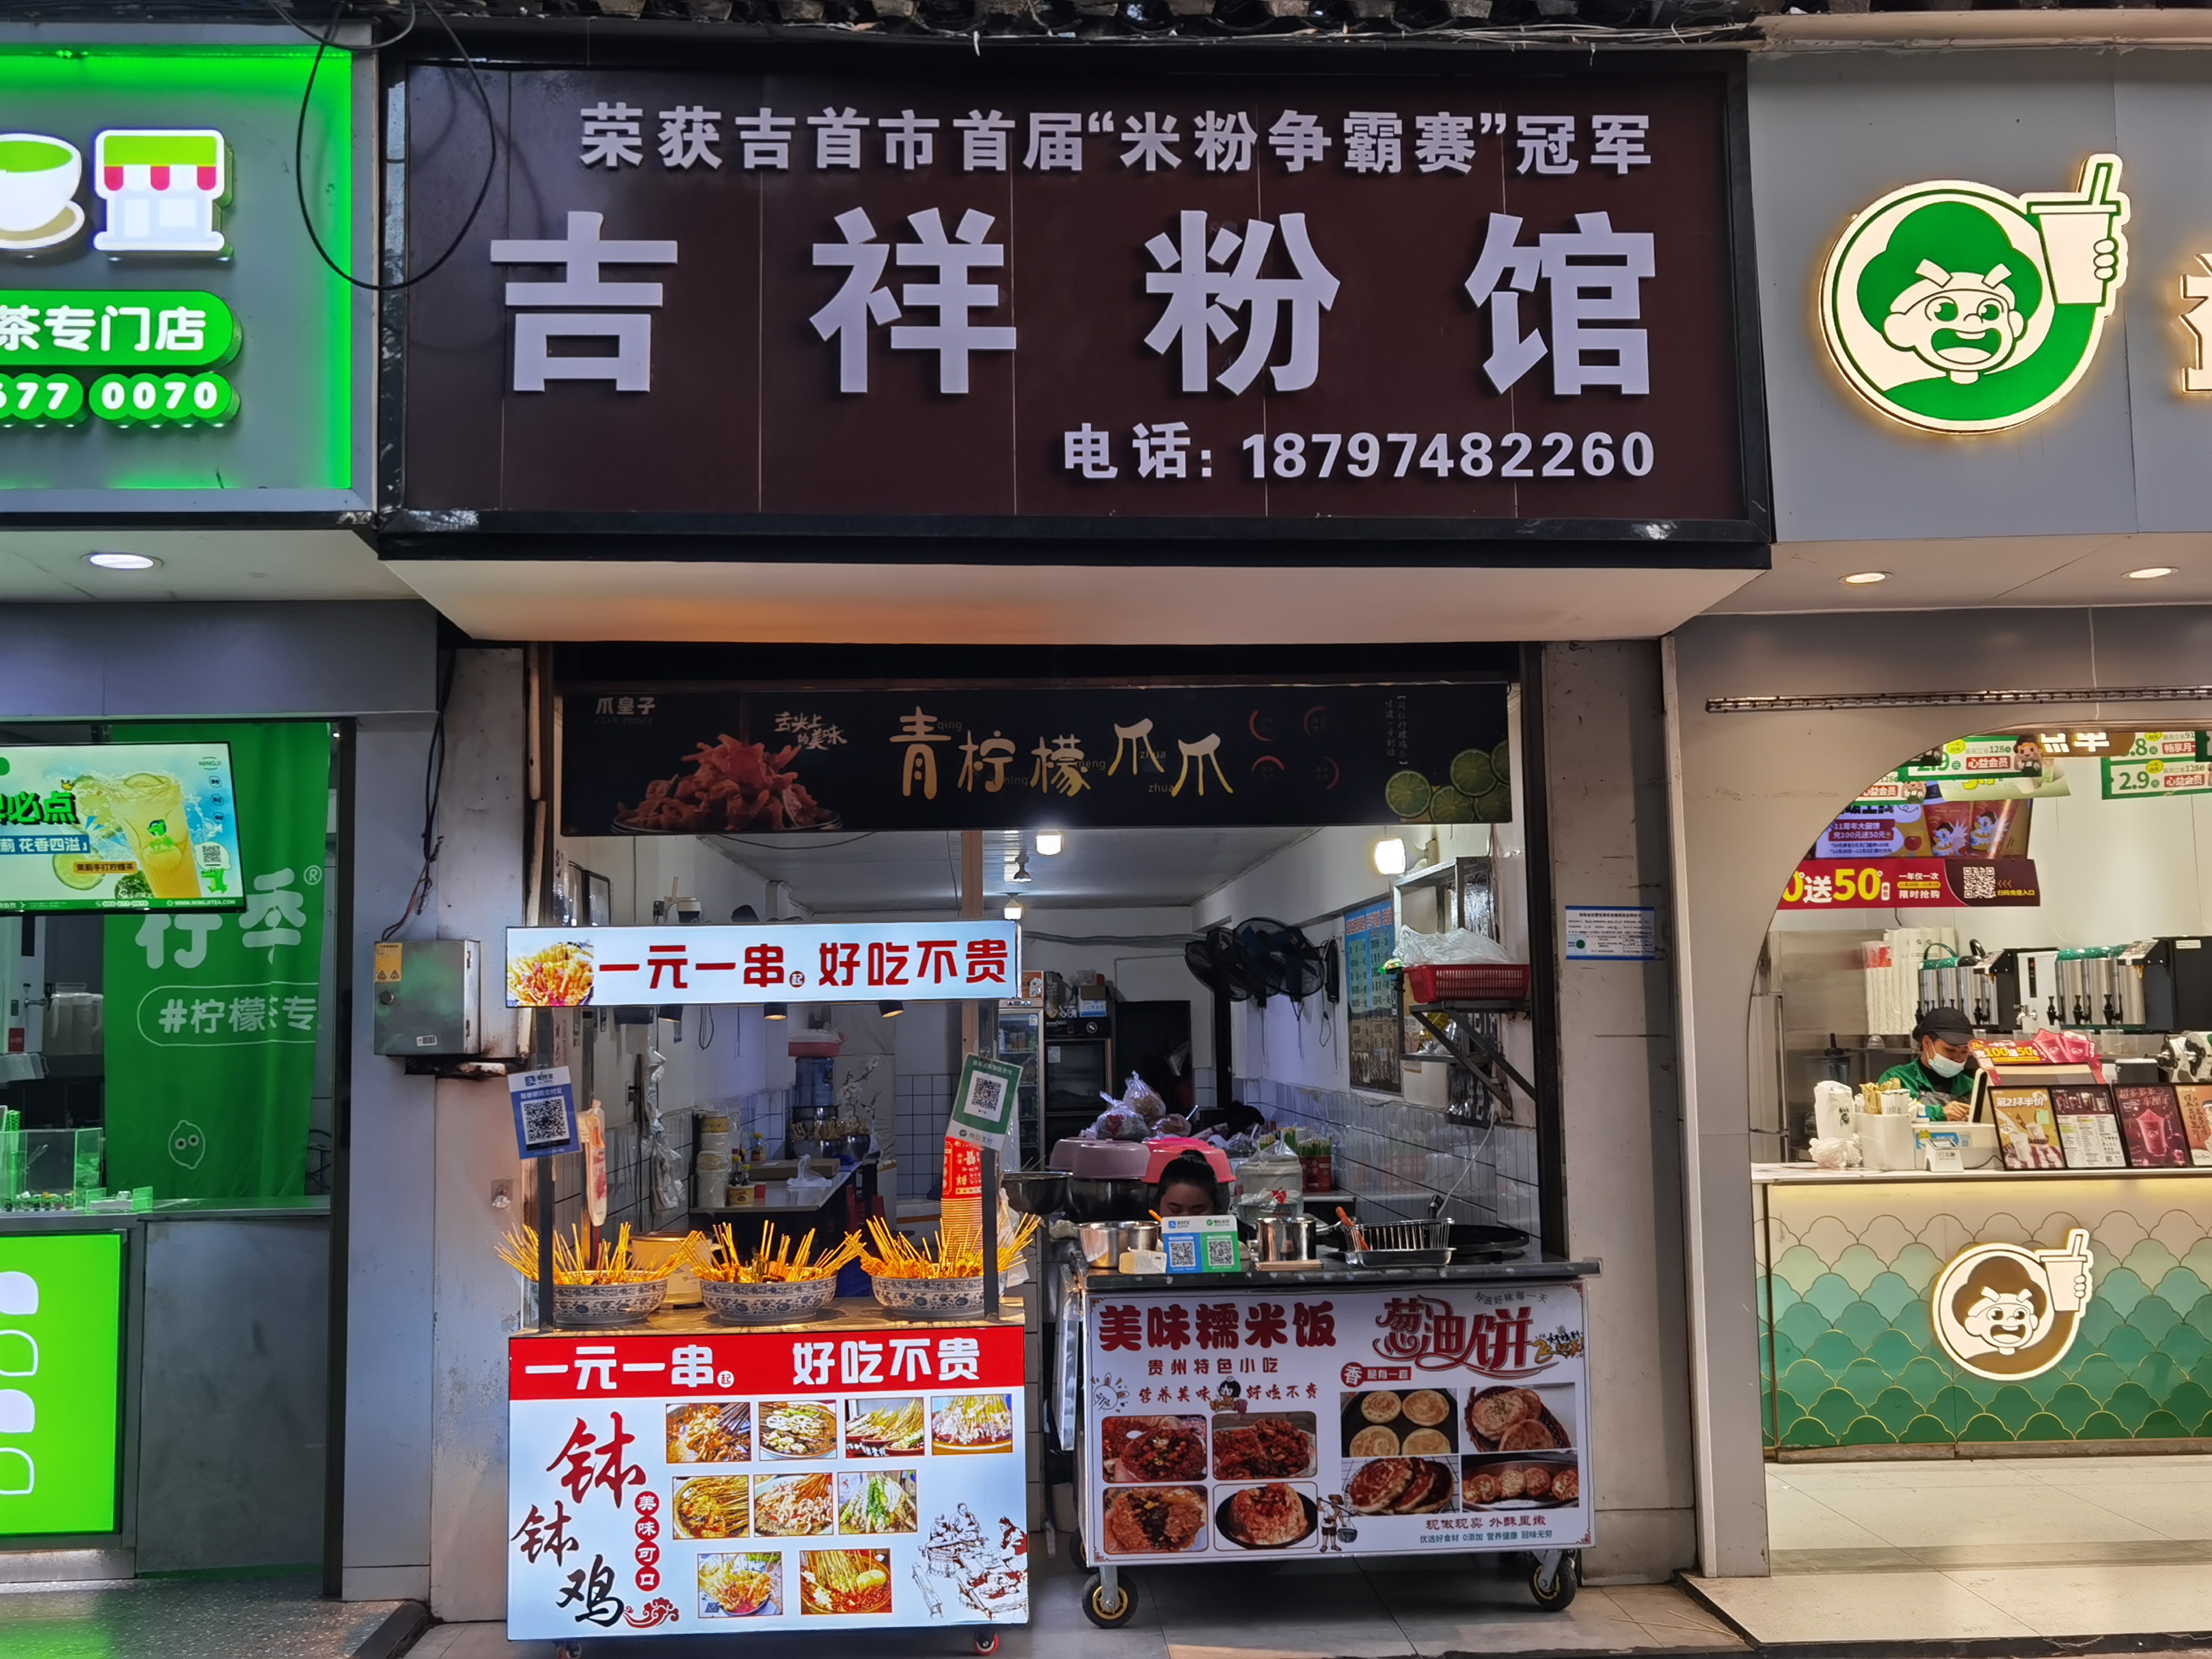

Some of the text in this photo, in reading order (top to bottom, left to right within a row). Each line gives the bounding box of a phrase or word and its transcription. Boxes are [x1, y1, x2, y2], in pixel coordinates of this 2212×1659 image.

[579, 102, 1651, 175] 荣获吉首市首届“米粉争霸赛”冠军
[490, 207, 1656, 396] 吉祥粉馆
[0, 304, 206, 352] 茶专门店
[102, 382, 217, 409] 0070
[595, 696, 656, 715] 爪皇子
[773, 711, 826, 733] 舌尖上
[938, 719, 962, 732] qing
[797, 724, 848, 750] 的美味
[2164, 742, 2195, 753] 畅享月
[889, 705, 1233, 800] 青柠檬爪爪
[1968, 757, 2008, 769] 心益会员
[2166, 775, 2202, 786] 心益会员
[0, 790, 80, 825] 必点
[1898, 872, 1939, 880] 一年仅一次
[1899, 889, 1940, 899] 限时抢购
[819, 939, 1009, 987] 好吃不贵
[1997, 1097, 2045, 1108] 第2杯半价
[1098, 1300, 1337, 1352] 美味糯米饭
[1372, 1294, 1549, 1378] 葱油饼
[792, 1337, 980, 1386] 好吃不贵
[1148, 1357, 1279, 1376] 贵州特色小吃
[636, 1492, 659, 1589] 美味可口
